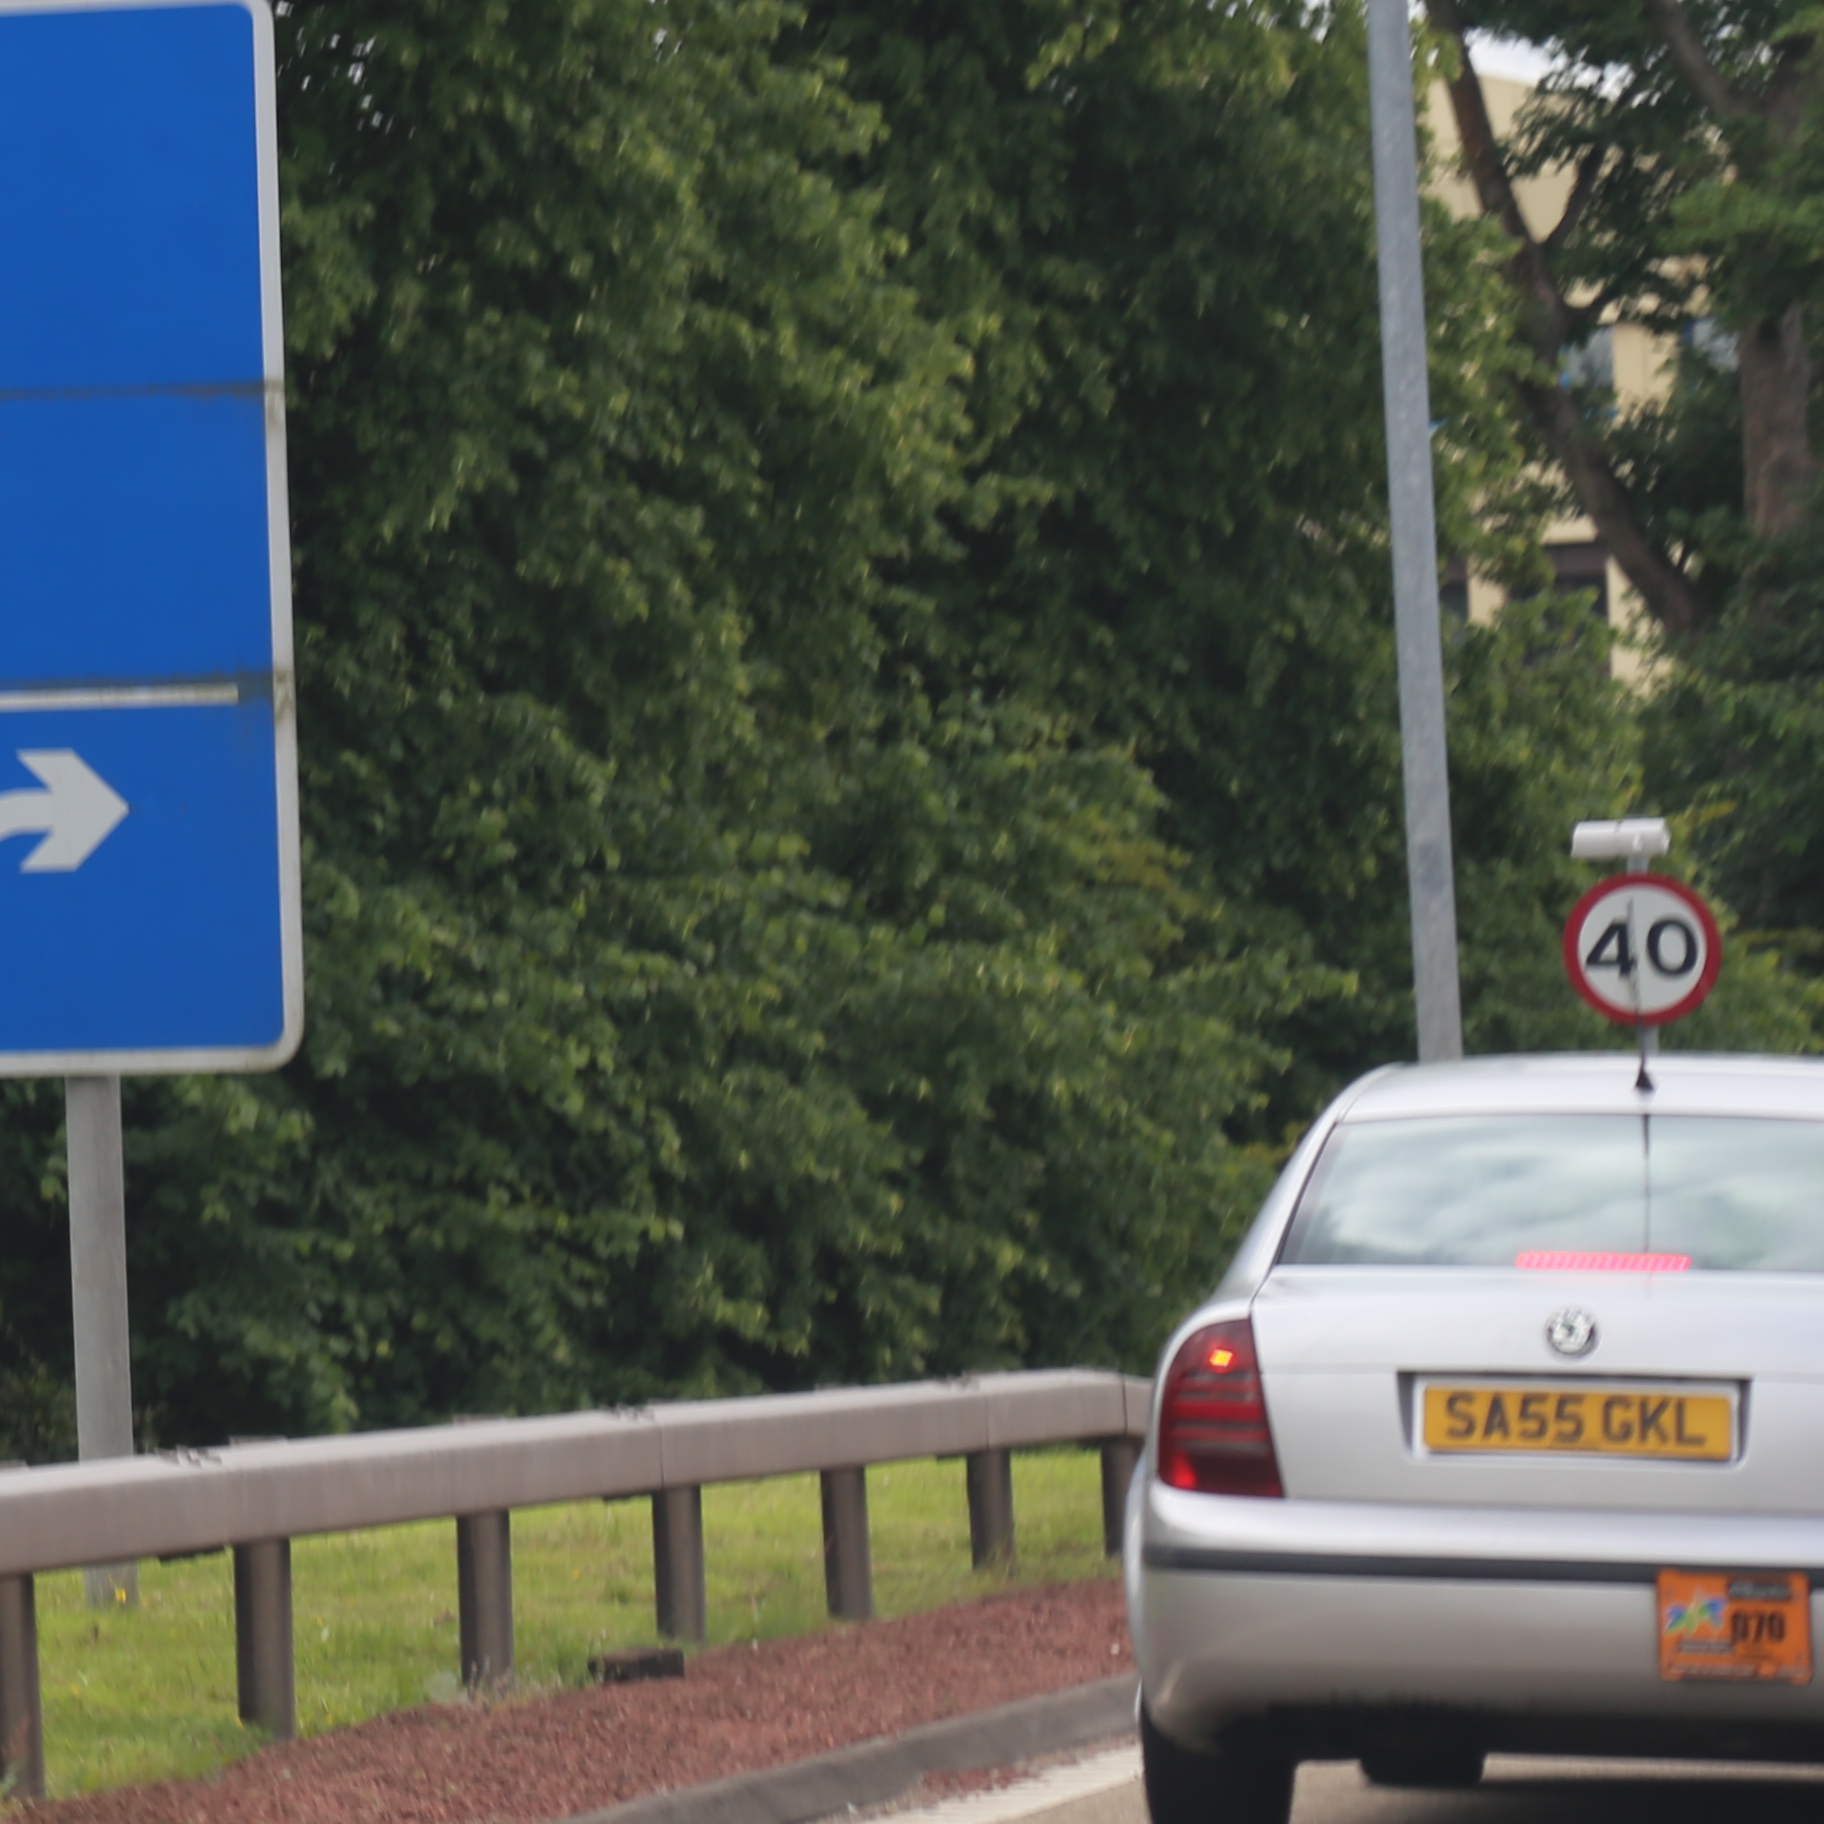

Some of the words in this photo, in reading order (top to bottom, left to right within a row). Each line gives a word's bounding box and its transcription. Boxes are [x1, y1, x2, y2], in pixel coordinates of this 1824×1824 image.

[1585, 915, 1699, 979] 40
[1446, 1391, 1586, 1443] SA55
[1602, 1395, 1707, 1446] GKL
